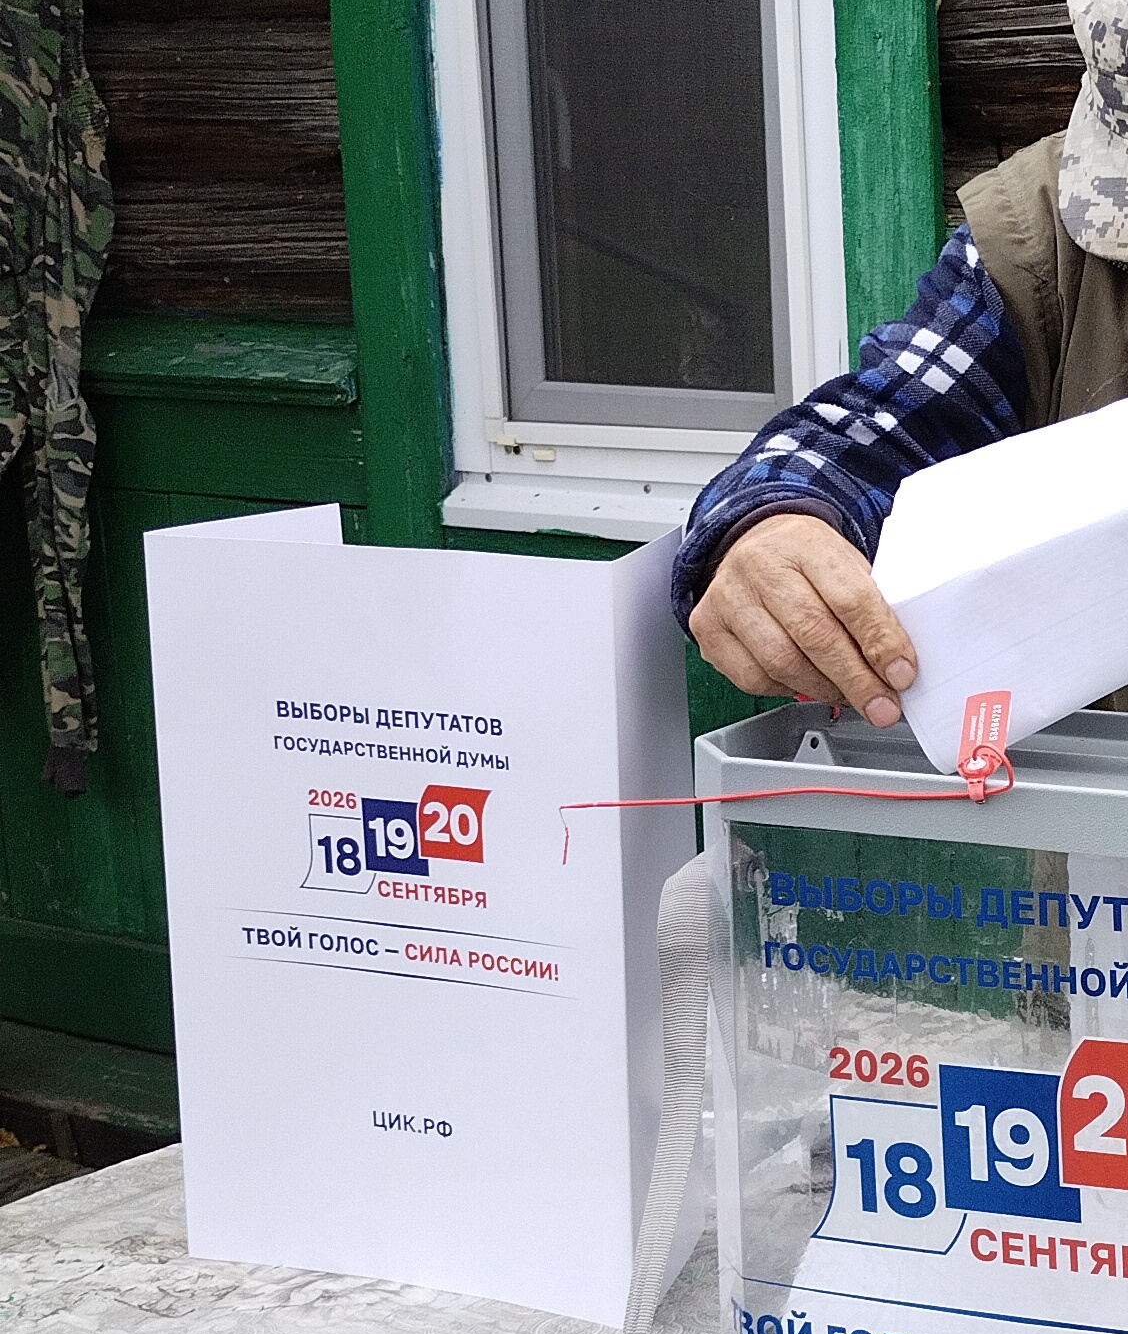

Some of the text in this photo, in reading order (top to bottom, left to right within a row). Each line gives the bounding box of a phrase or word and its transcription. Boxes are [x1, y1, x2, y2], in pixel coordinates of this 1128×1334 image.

[276, 700, 503, 736] ВЫБОРЫ ДЕПУТАТОВ
[274, 735, 510, 771] ГОСУДАРСТВЕННОЙ ДУМЫ
[308, 789, 357, 810] 2026
[317, 801, 479, 876] 18 19 20
[377, 880, 488, 909] СЕНТЯБРЯ
[769, 871, 962, 920] ВЫБОРЫ
[242, 926, 302, 949] ТВОЙ
[308, 932, 380, 956] ГОЛОС
[404, 943, 463, 967] СИЛА
[468, 951, 560, 982] РОССИИ!
[829, 1046, 931, 1089] 2026
[372, 1110, 454, 1138] ЦИК.РФ
[845, 1137, 938, 1220] 18
[954, 1103, 1051, 1188] 19
